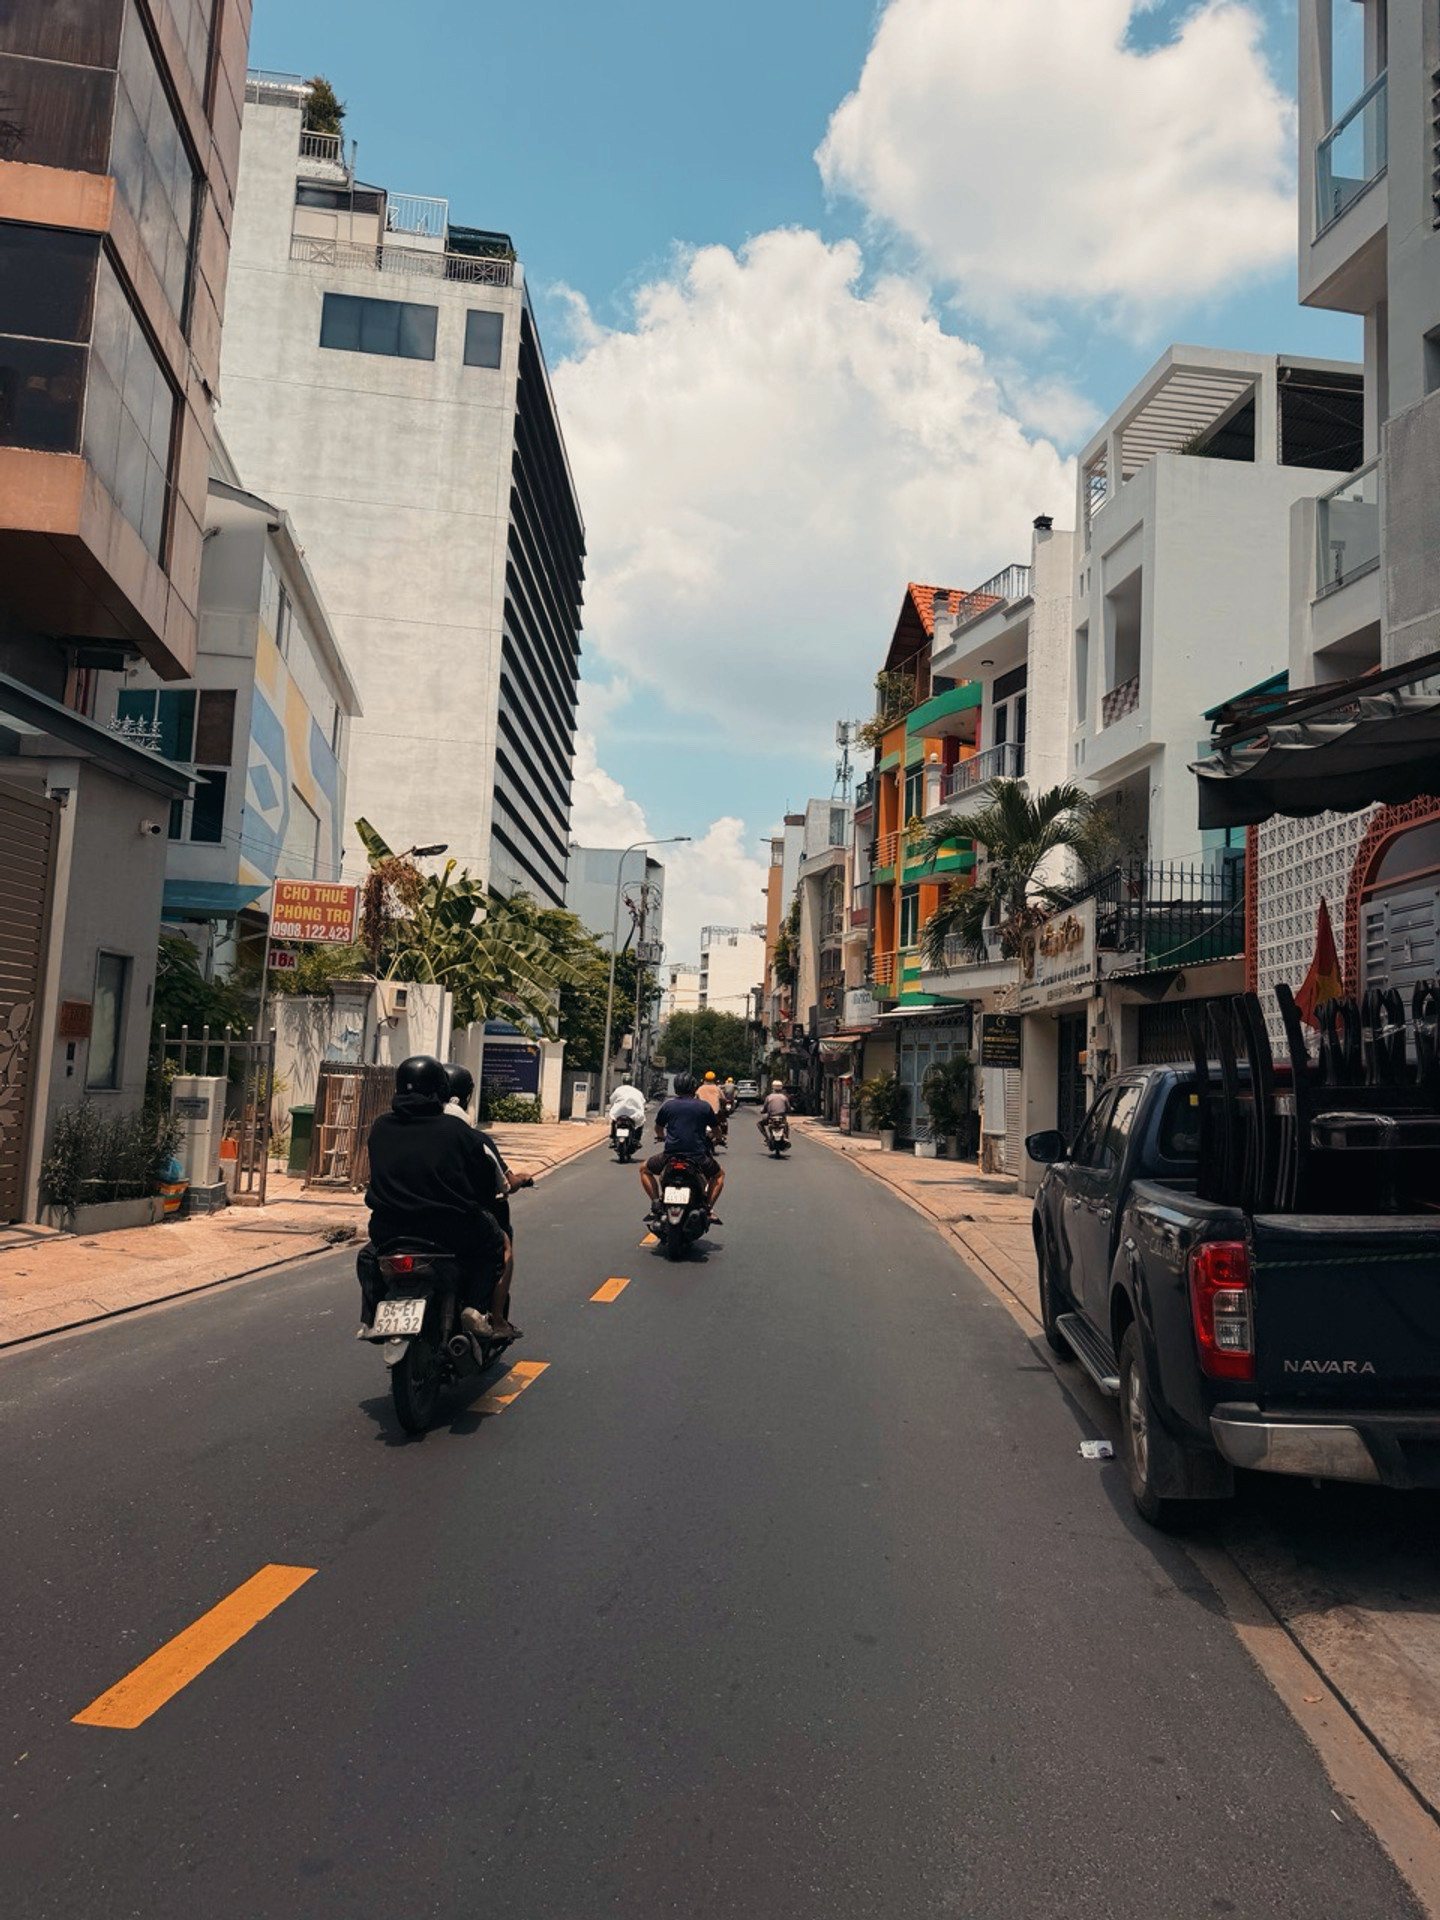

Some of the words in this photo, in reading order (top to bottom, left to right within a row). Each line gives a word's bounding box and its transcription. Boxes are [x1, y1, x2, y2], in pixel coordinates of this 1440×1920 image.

[282, 885, 311, 901] CHO
[314, 886, 349, 905] THUÊ
[275, 902, 322, 921] PHÒNG
[326, 907, 352, 927] TRỌ
[273, 921, 350, 941] 0908.122.423
[377, 1317, 420, 1334] 521.32
[1283, 1360, 1377, 1374] NAVARA
